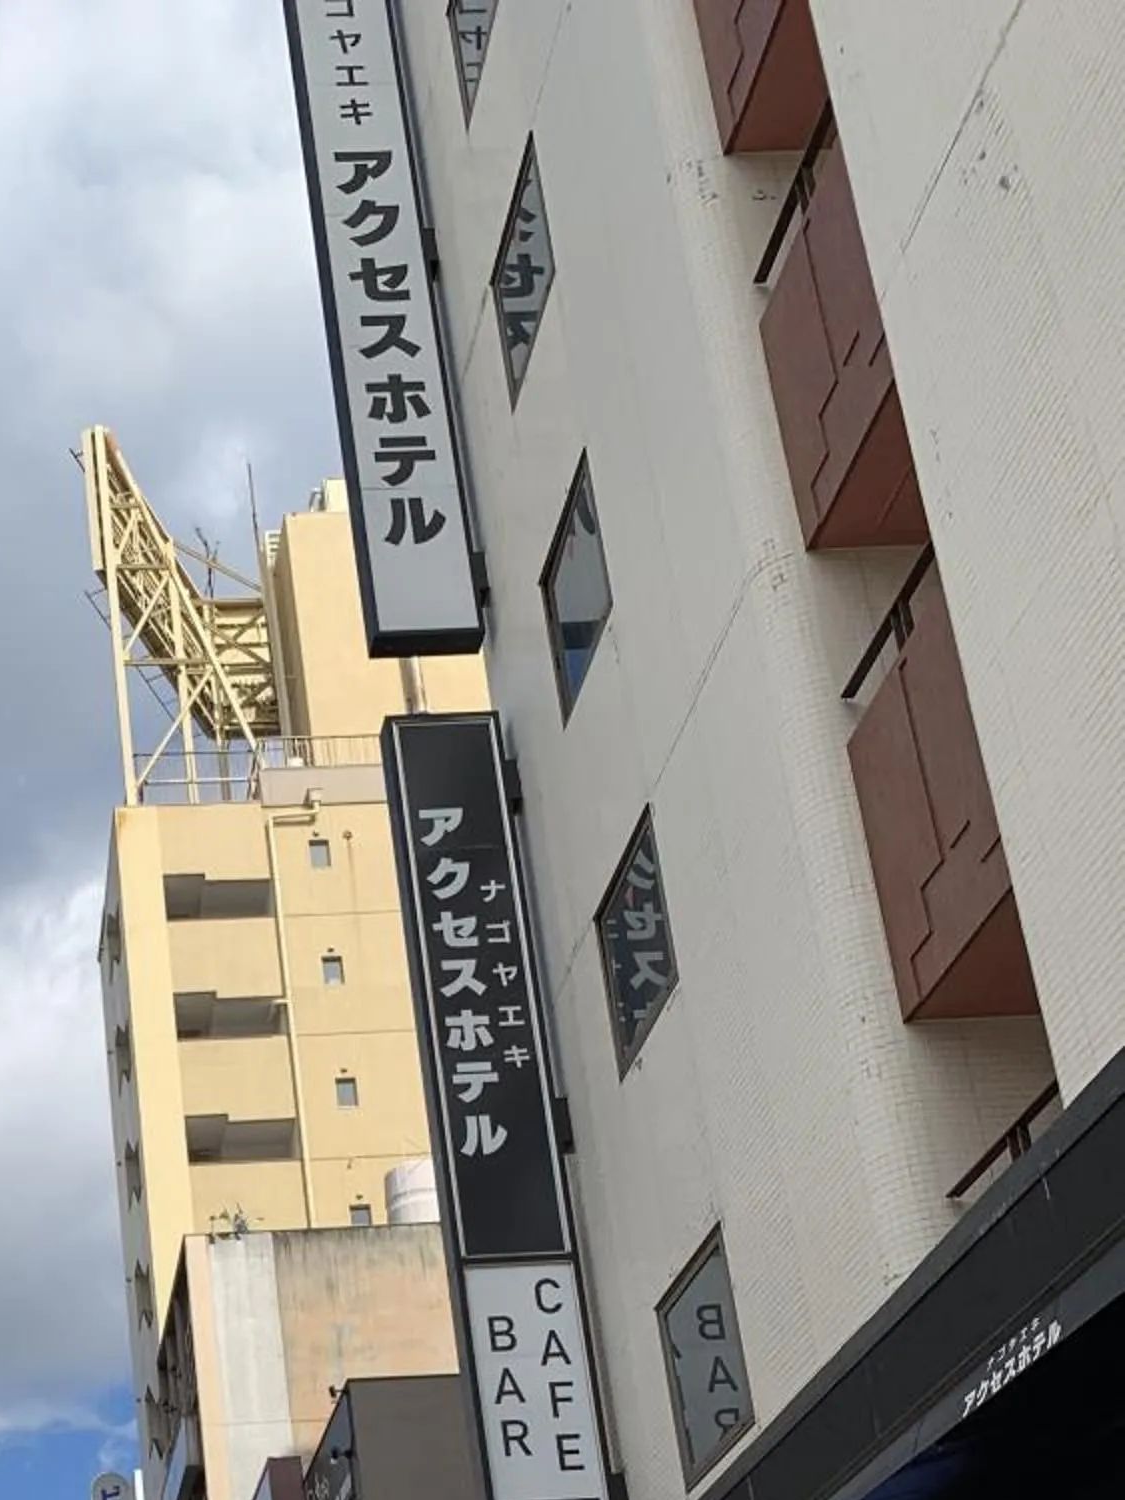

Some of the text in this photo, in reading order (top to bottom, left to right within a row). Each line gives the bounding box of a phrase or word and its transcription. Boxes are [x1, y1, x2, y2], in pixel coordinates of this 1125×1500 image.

[333, 150, 446, 547] アクセスホテル
[418, 807, 508, 1158] アクセスホテル
[480, 879, 530, 1069] ナゴヤエキ
[487, 1316, 533, 1456] BAR
[534, 1278, 586, 1471] CAFE
[962, 1319, 1062, 1418] アクセスホテル
